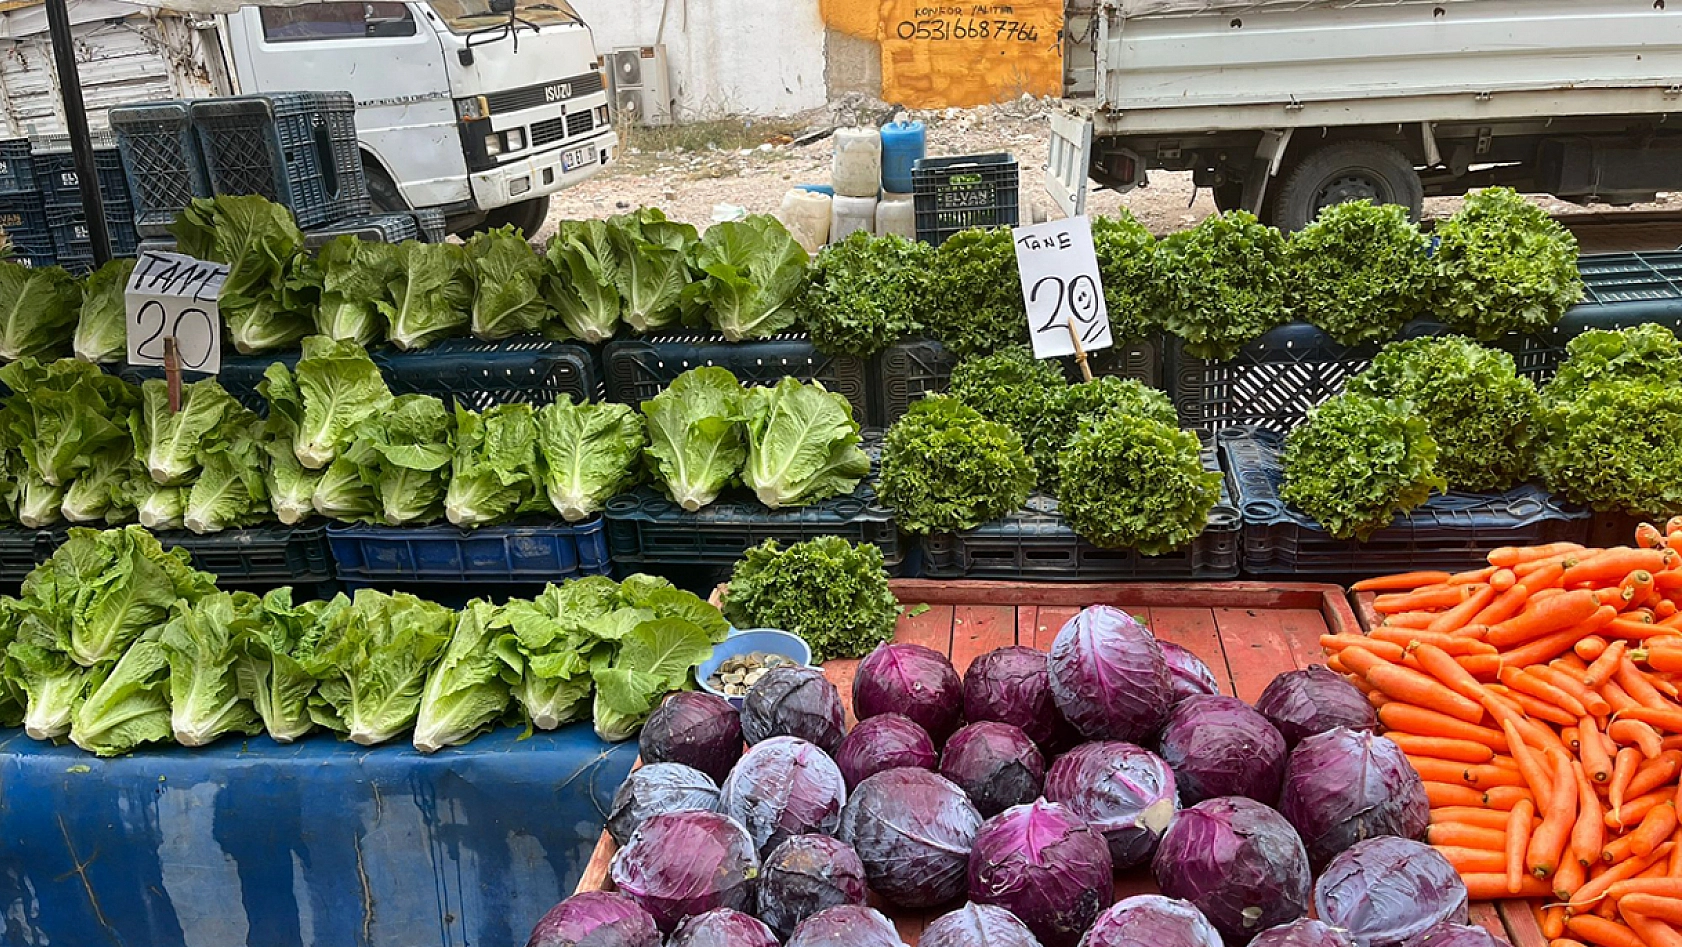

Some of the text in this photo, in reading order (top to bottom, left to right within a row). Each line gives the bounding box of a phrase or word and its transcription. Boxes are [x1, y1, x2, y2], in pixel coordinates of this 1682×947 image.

[914, 7, 963, 18] KONFOR
[544, 83, 573, 102] ISUZU
[945, 190, 987, 203] ELVAN
[1017, 231, 1073, 250] TANE
[136, 300, 214, 368] 20
